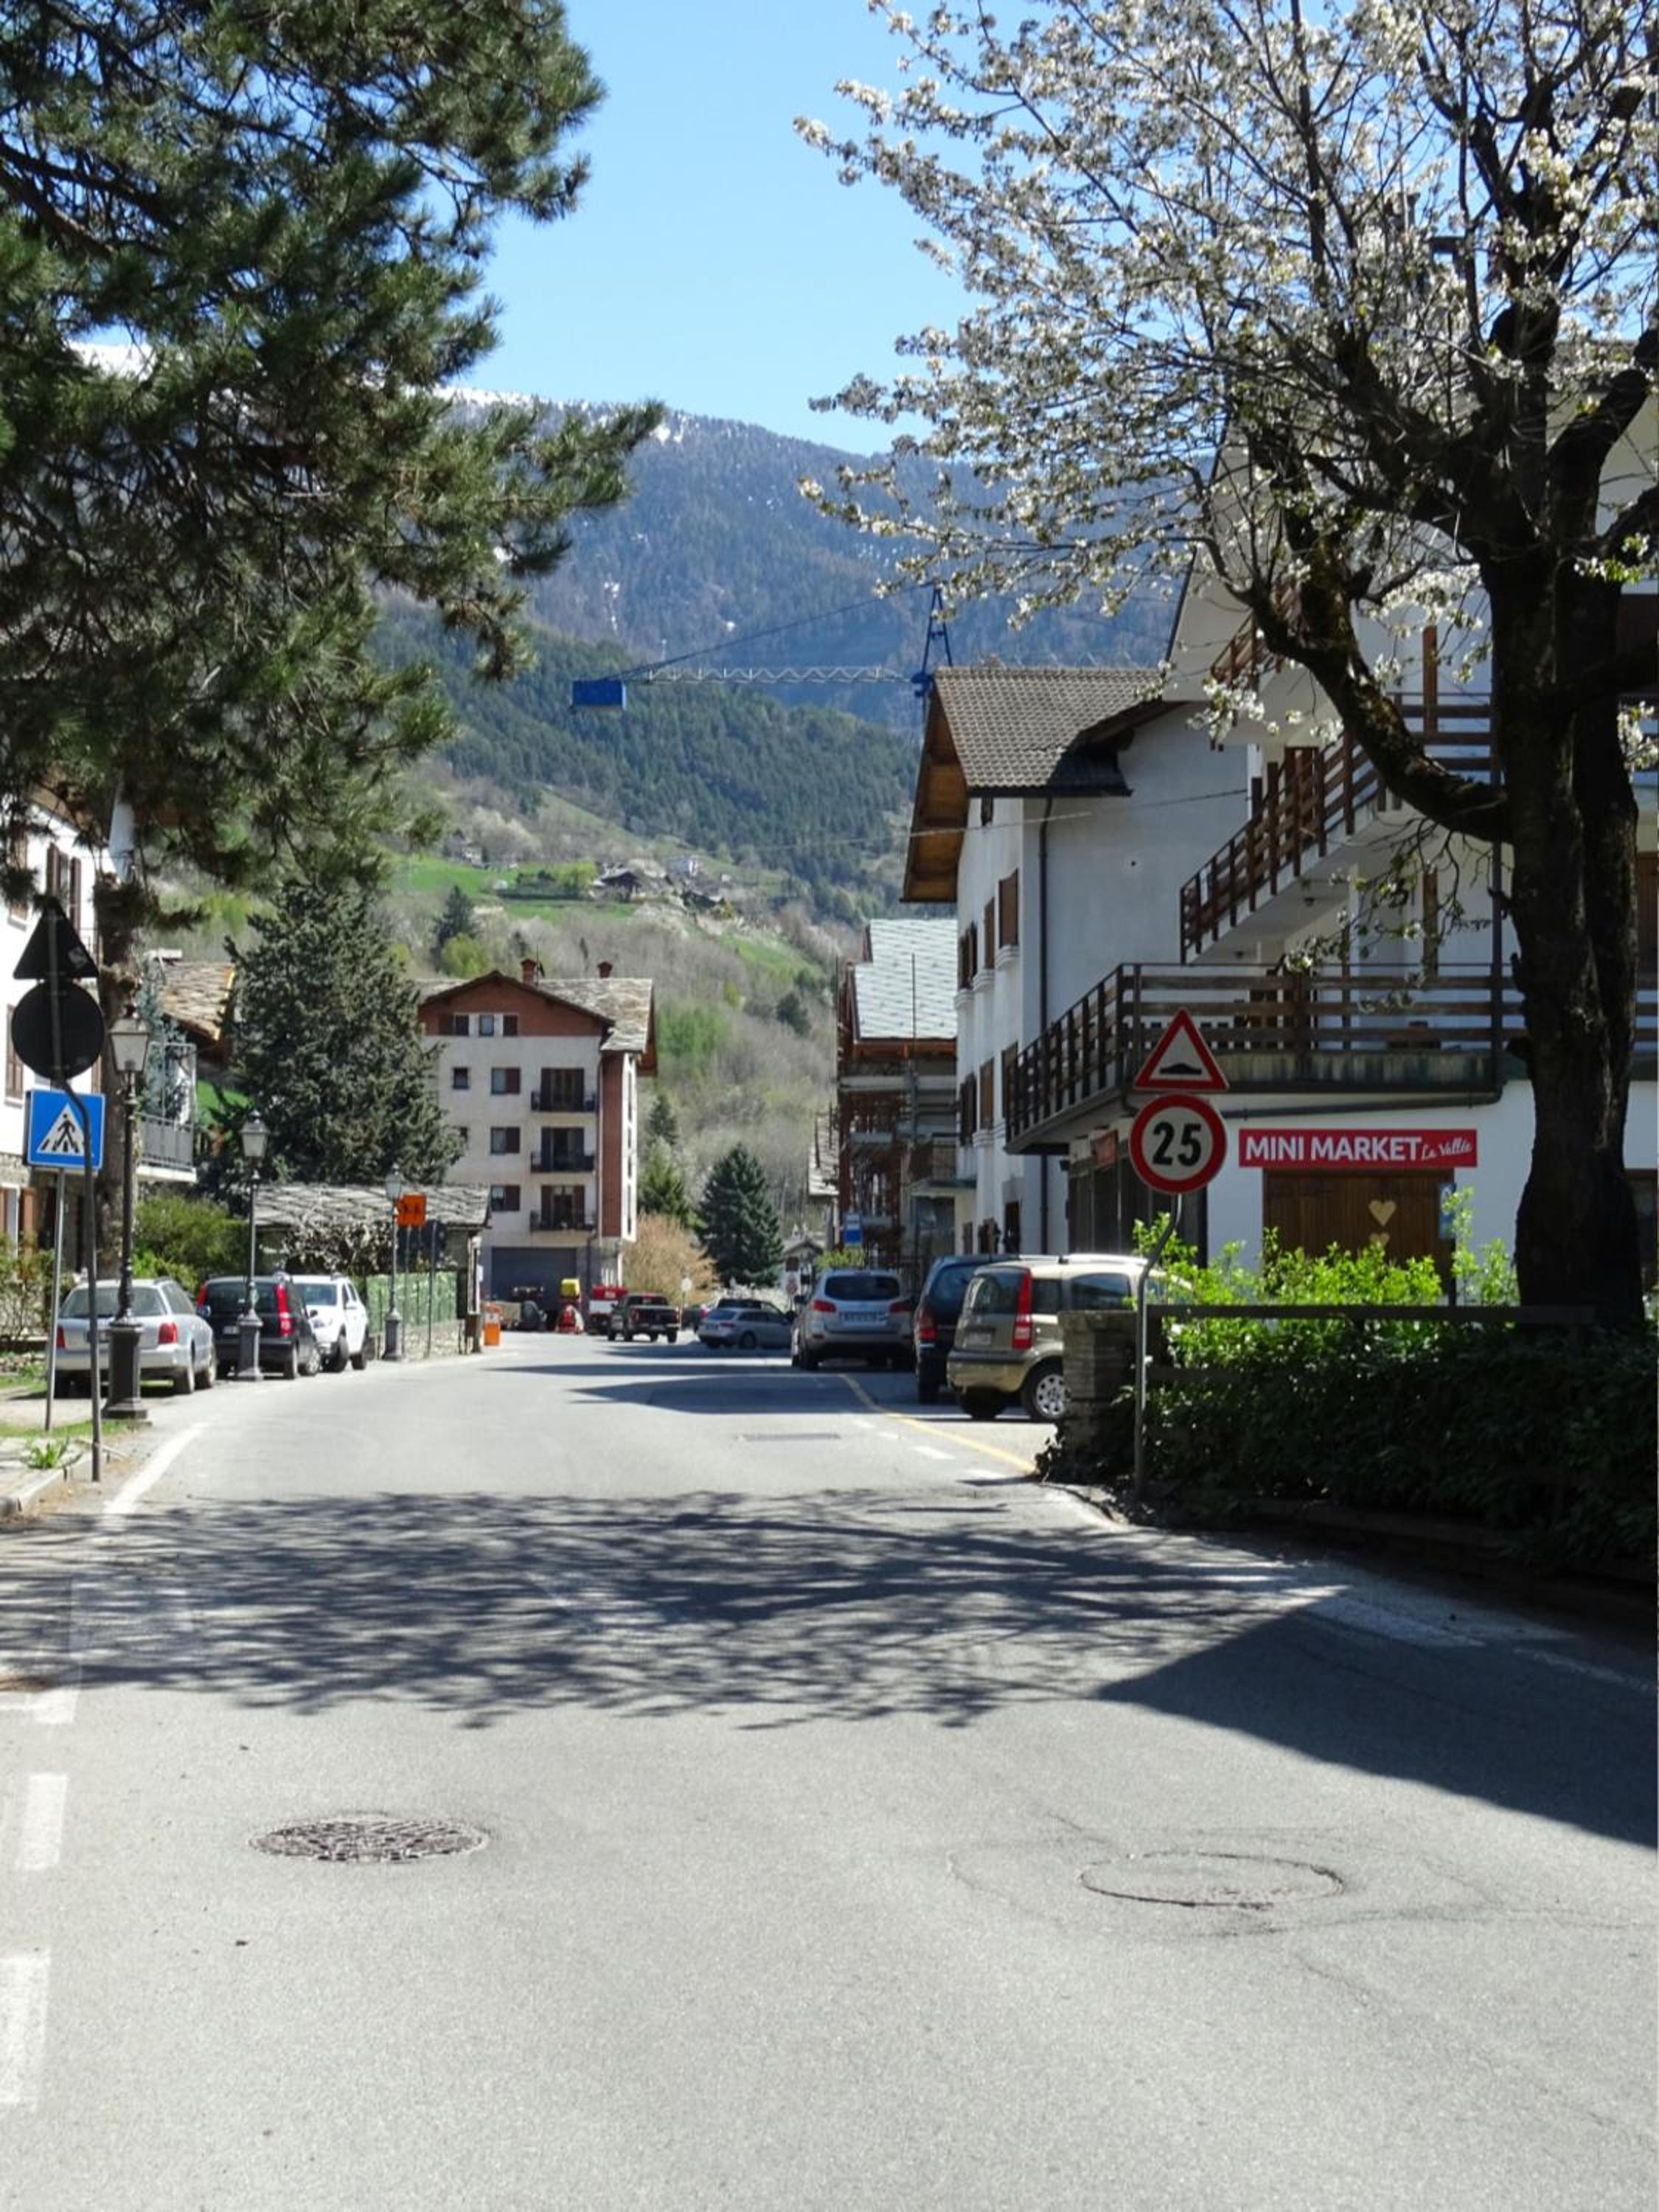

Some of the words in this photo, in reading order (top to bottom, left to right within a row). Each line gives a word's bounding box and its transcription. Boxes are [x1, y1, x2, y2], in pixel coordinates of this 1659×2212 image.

[1152, 1121, 1202, 1166] 25
[1245, 1136, 1304, 1161] MINI
[1310, 1136, 1422, 1161] MARKET
